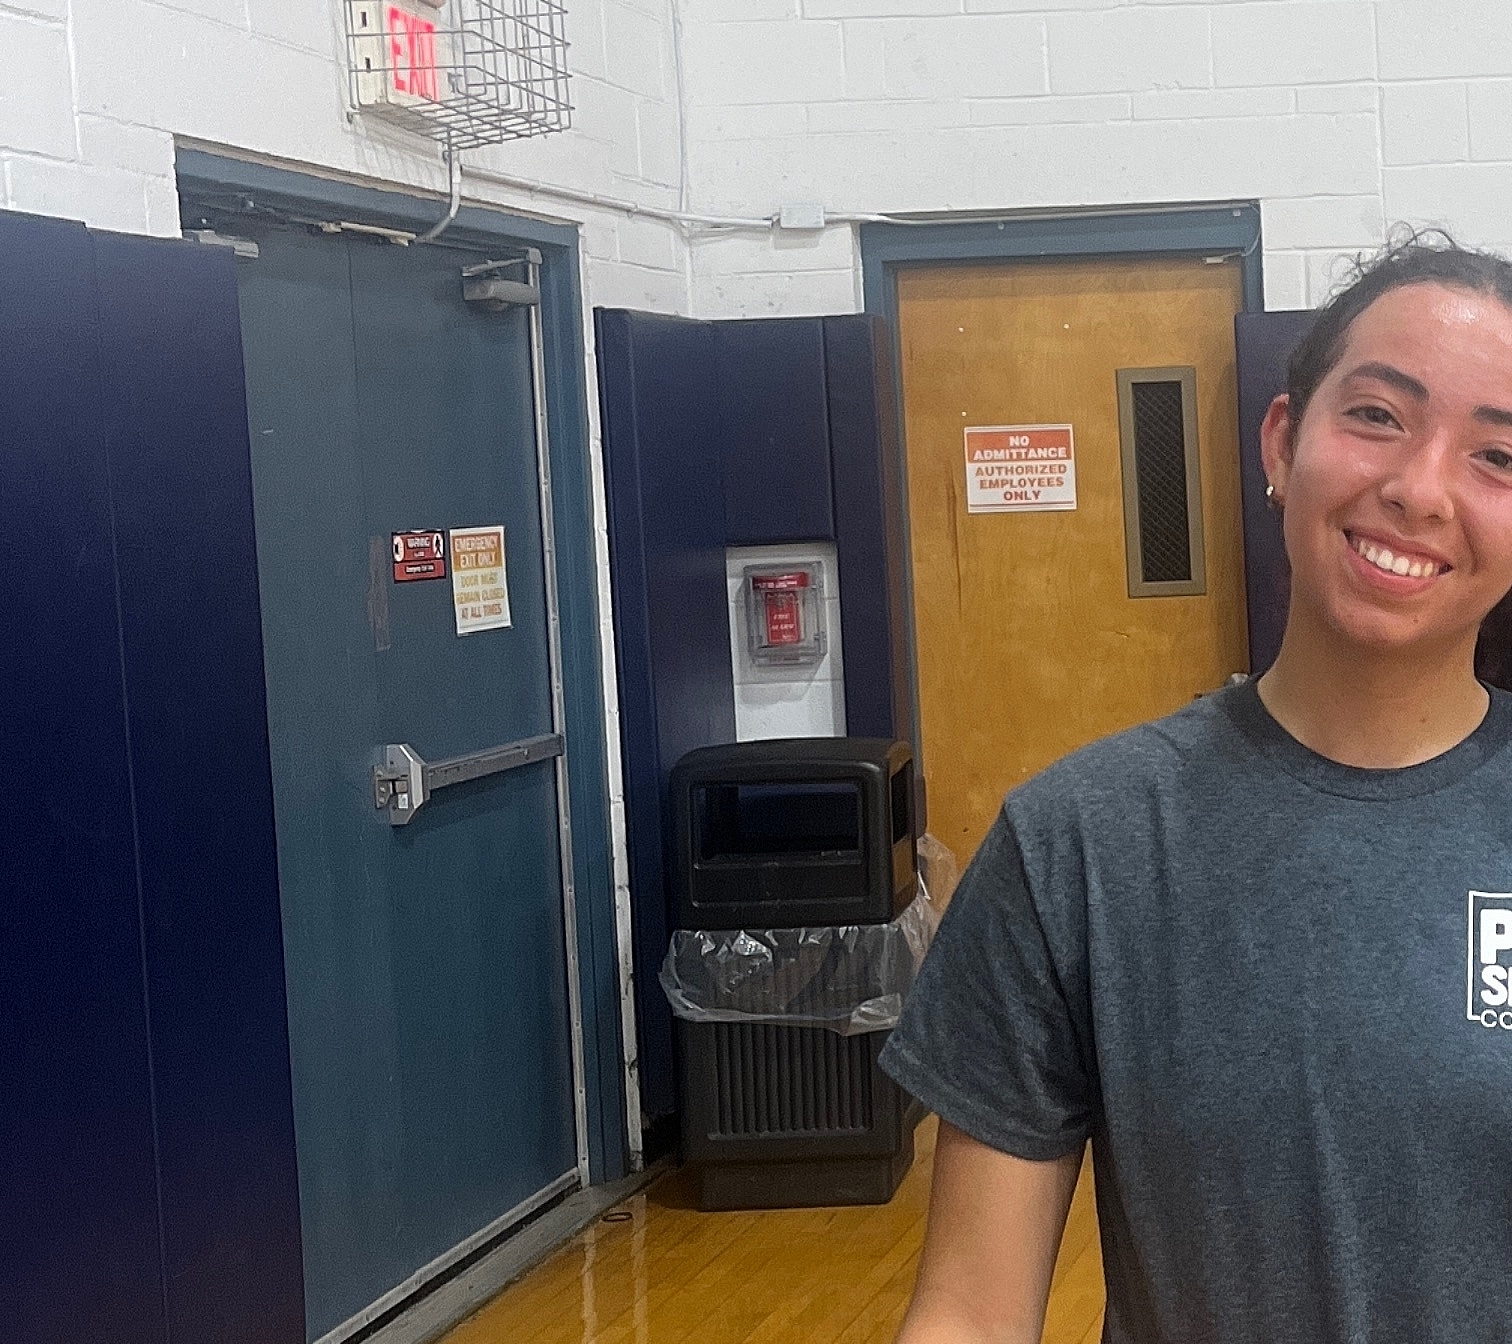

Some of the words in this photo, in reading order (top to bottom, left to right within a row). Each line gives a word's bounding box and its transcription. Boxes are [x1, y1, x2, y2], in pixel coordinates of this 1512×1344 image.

[1009, 436, 1030, 447] NO
[973, 447, 1067, 461] ADMITTANCE
[975, 464, 1067, 477] AUTHORIZED
[980, 477, 1064, 489] EMPLOYEES
[1003, 490, 1041, 501] ONLY
